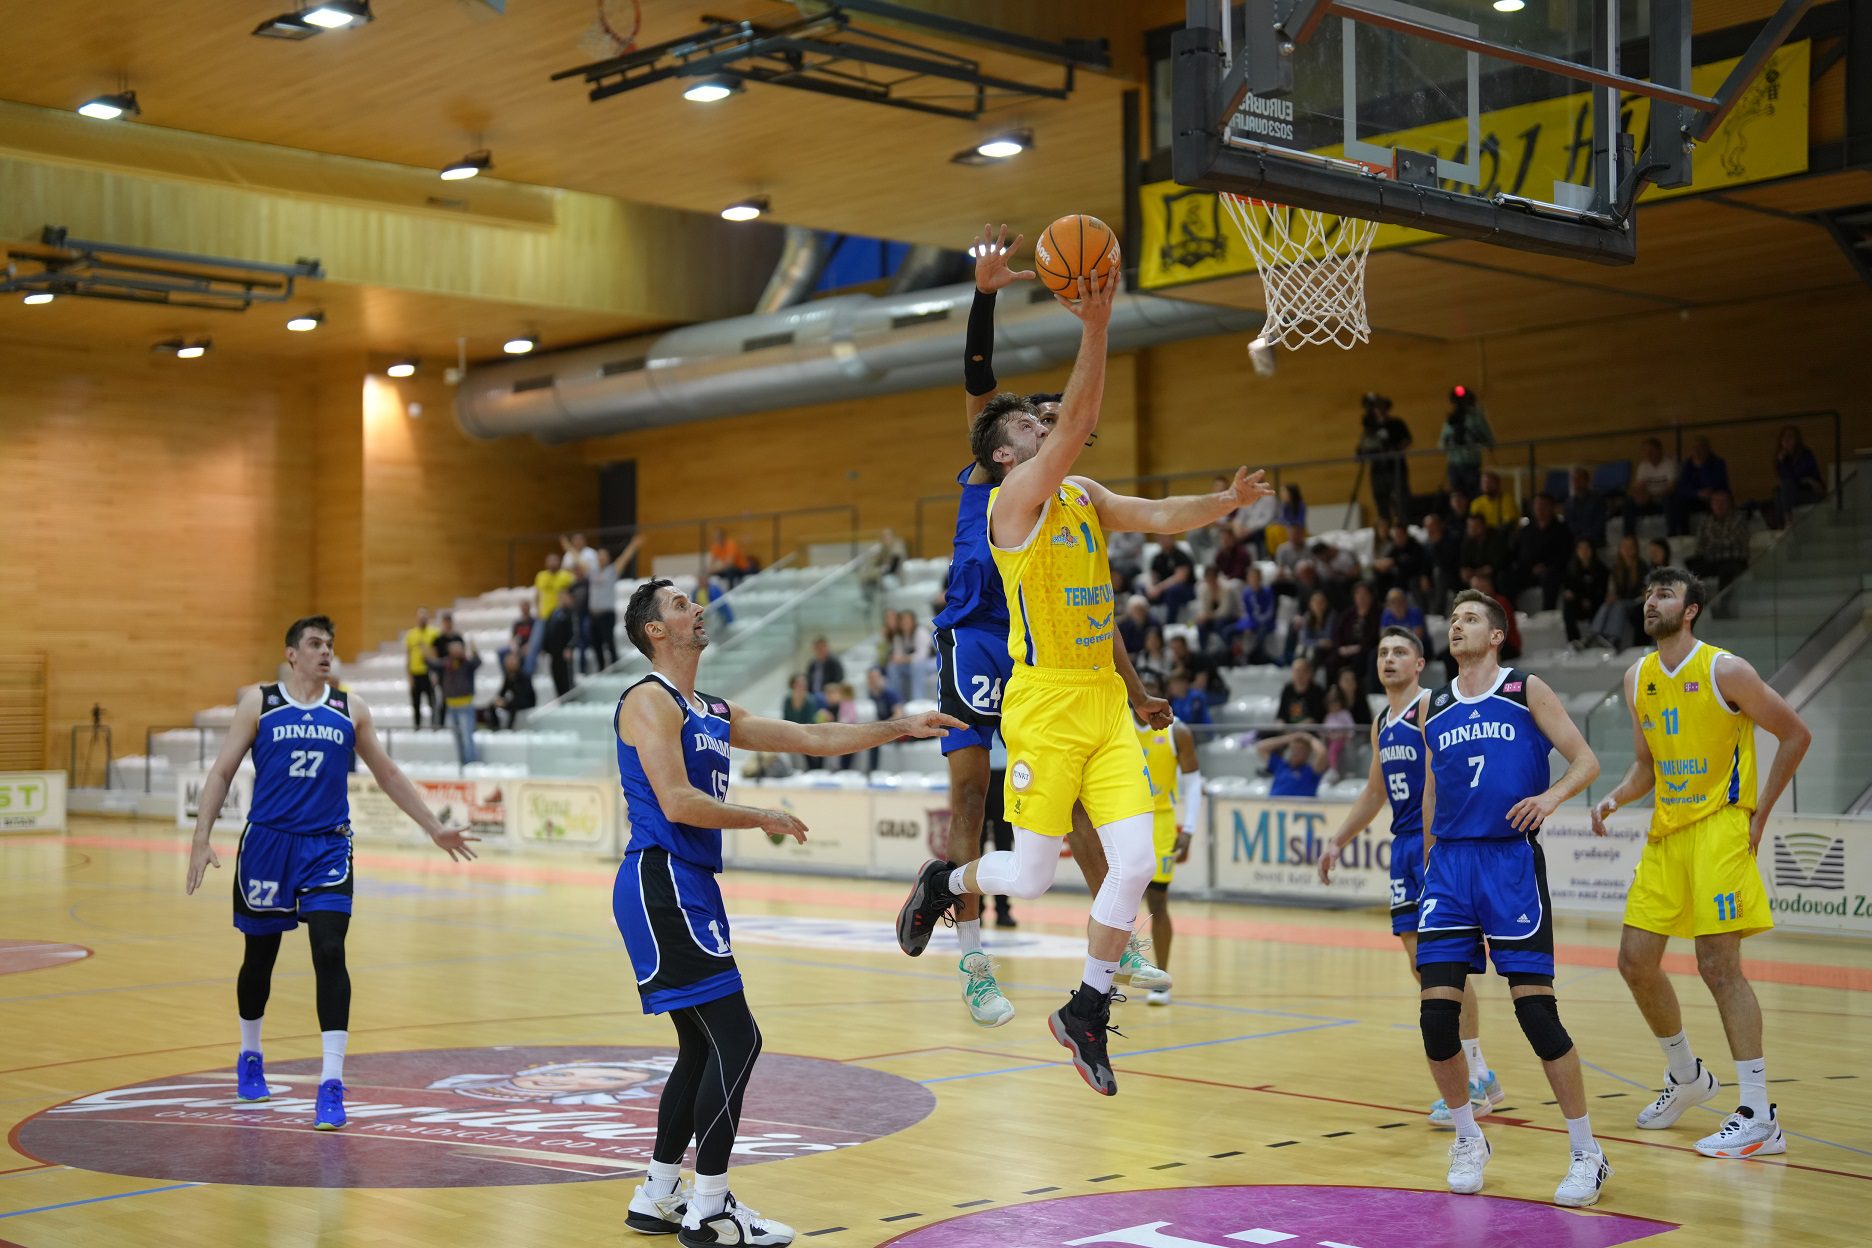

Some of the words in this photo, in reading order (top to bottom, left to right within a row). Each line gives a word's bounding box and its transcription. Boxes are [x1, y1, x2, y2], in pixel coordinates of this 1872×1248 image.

[272, 725, 344, 745] DINAMO
[1661, 707, 1679, 735] 11
[1438, 721, 1516, 752] DINAMO
[289, 750, 324, 778] 27
[1468, 755, 1485, 788] 7
[711, 769, 728, 802] 15
[1388, 773, 1409, 801] 55
[877, 819, 920, 839] GRAD
[248, 879, 279, 907] 27
[1713, 892, 1736, 920] 11
[1769, 893, 1847, 916] vodovod
[1418, 898, 1438, 928] 7
[360, 1122, 535, 1145] TRADICIJA
[539, 1138, 597, 1151] OD
